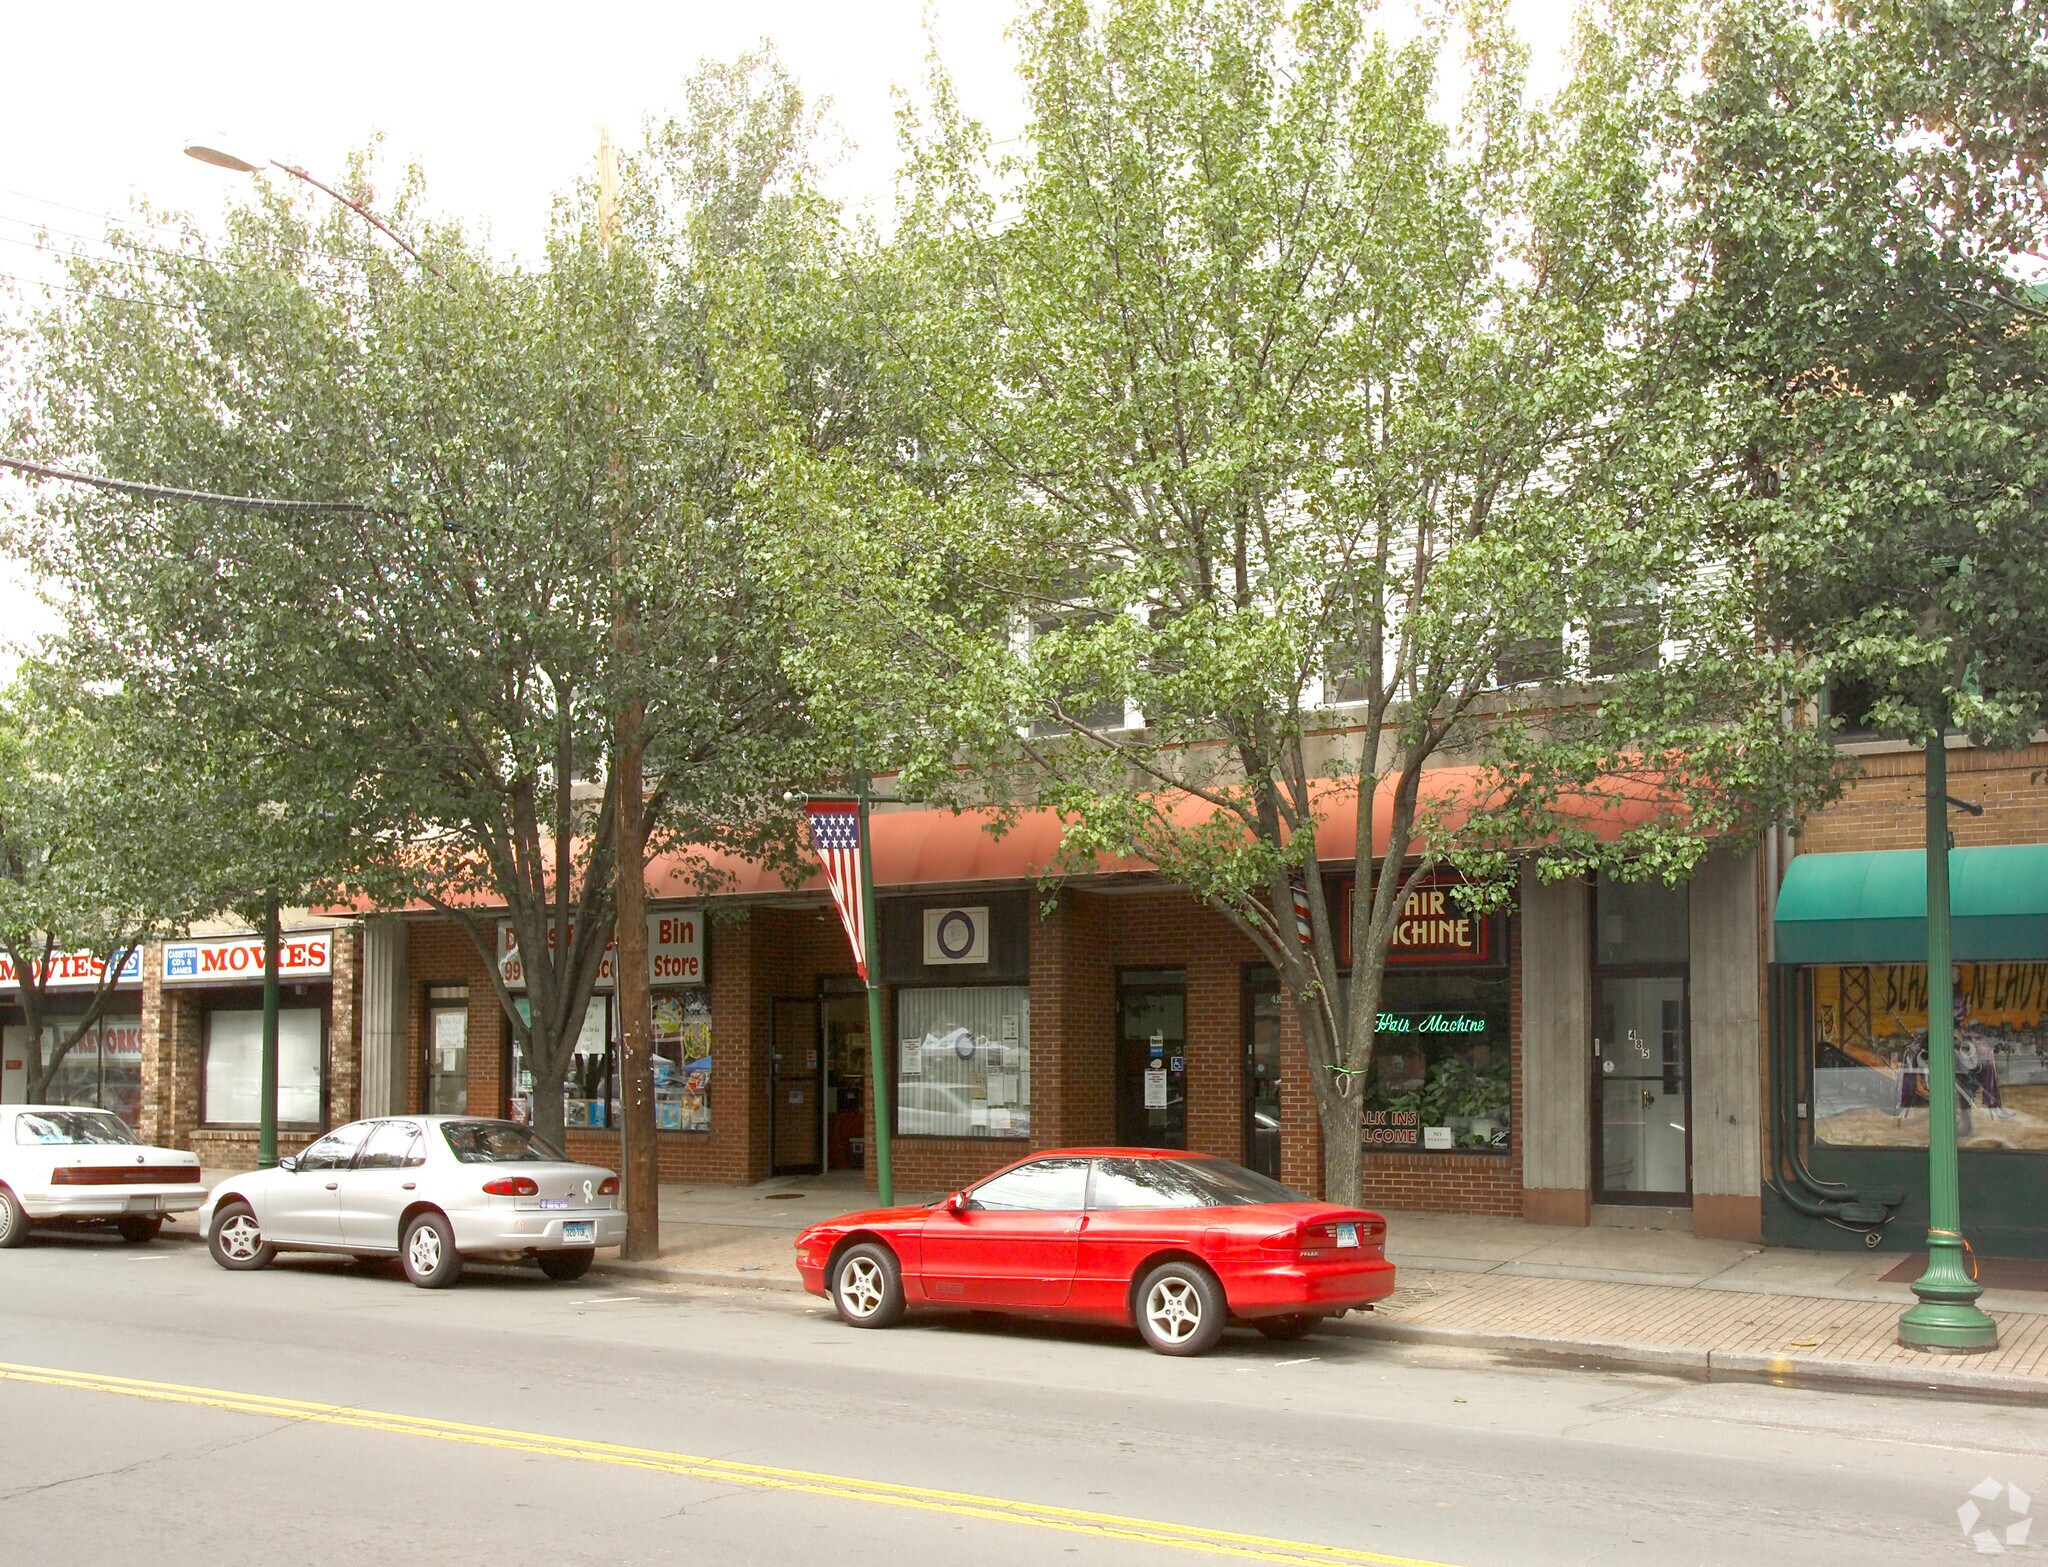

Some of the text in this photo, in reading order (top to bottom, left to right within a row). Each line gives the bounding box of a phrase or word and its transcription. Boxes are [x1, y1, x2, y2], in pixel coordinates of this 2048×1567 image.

[1396, 891, 1445, 916] AIR
[659, 917, 694, 944] Bin
[1393, 919, 1472, 947] CHINE
[168, 949, 197, 959] CASSETTES
[171, 966, 193, 975] GAMES
[654, 955, 698, 977] Store
[1374, 1013, 1485, 1033] Hair Machine
[1361, 1110, 1417, 1126] LK INS
[1361, 1128, 1417, 1144] LCOME
